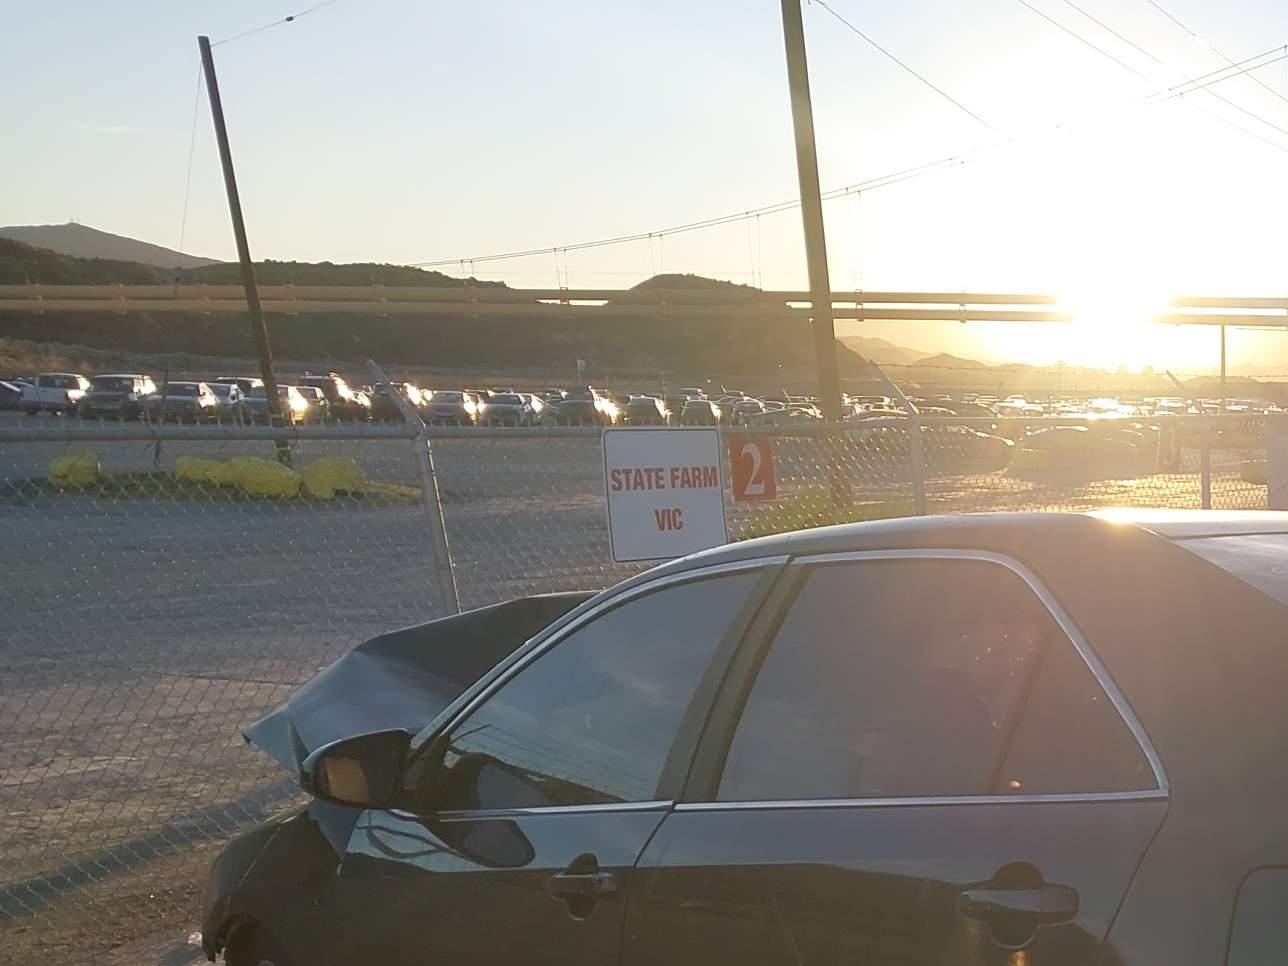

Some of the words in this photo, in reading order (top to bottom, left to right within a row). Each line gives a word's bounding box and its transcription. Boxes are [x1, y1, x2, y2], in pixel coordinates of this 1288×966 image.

[610, 467, 665, 491] STATE
[670, 466, 719, 489] FARM
[740, 442, 765, 496] 2
[655, 508, 684, 531] VIC
